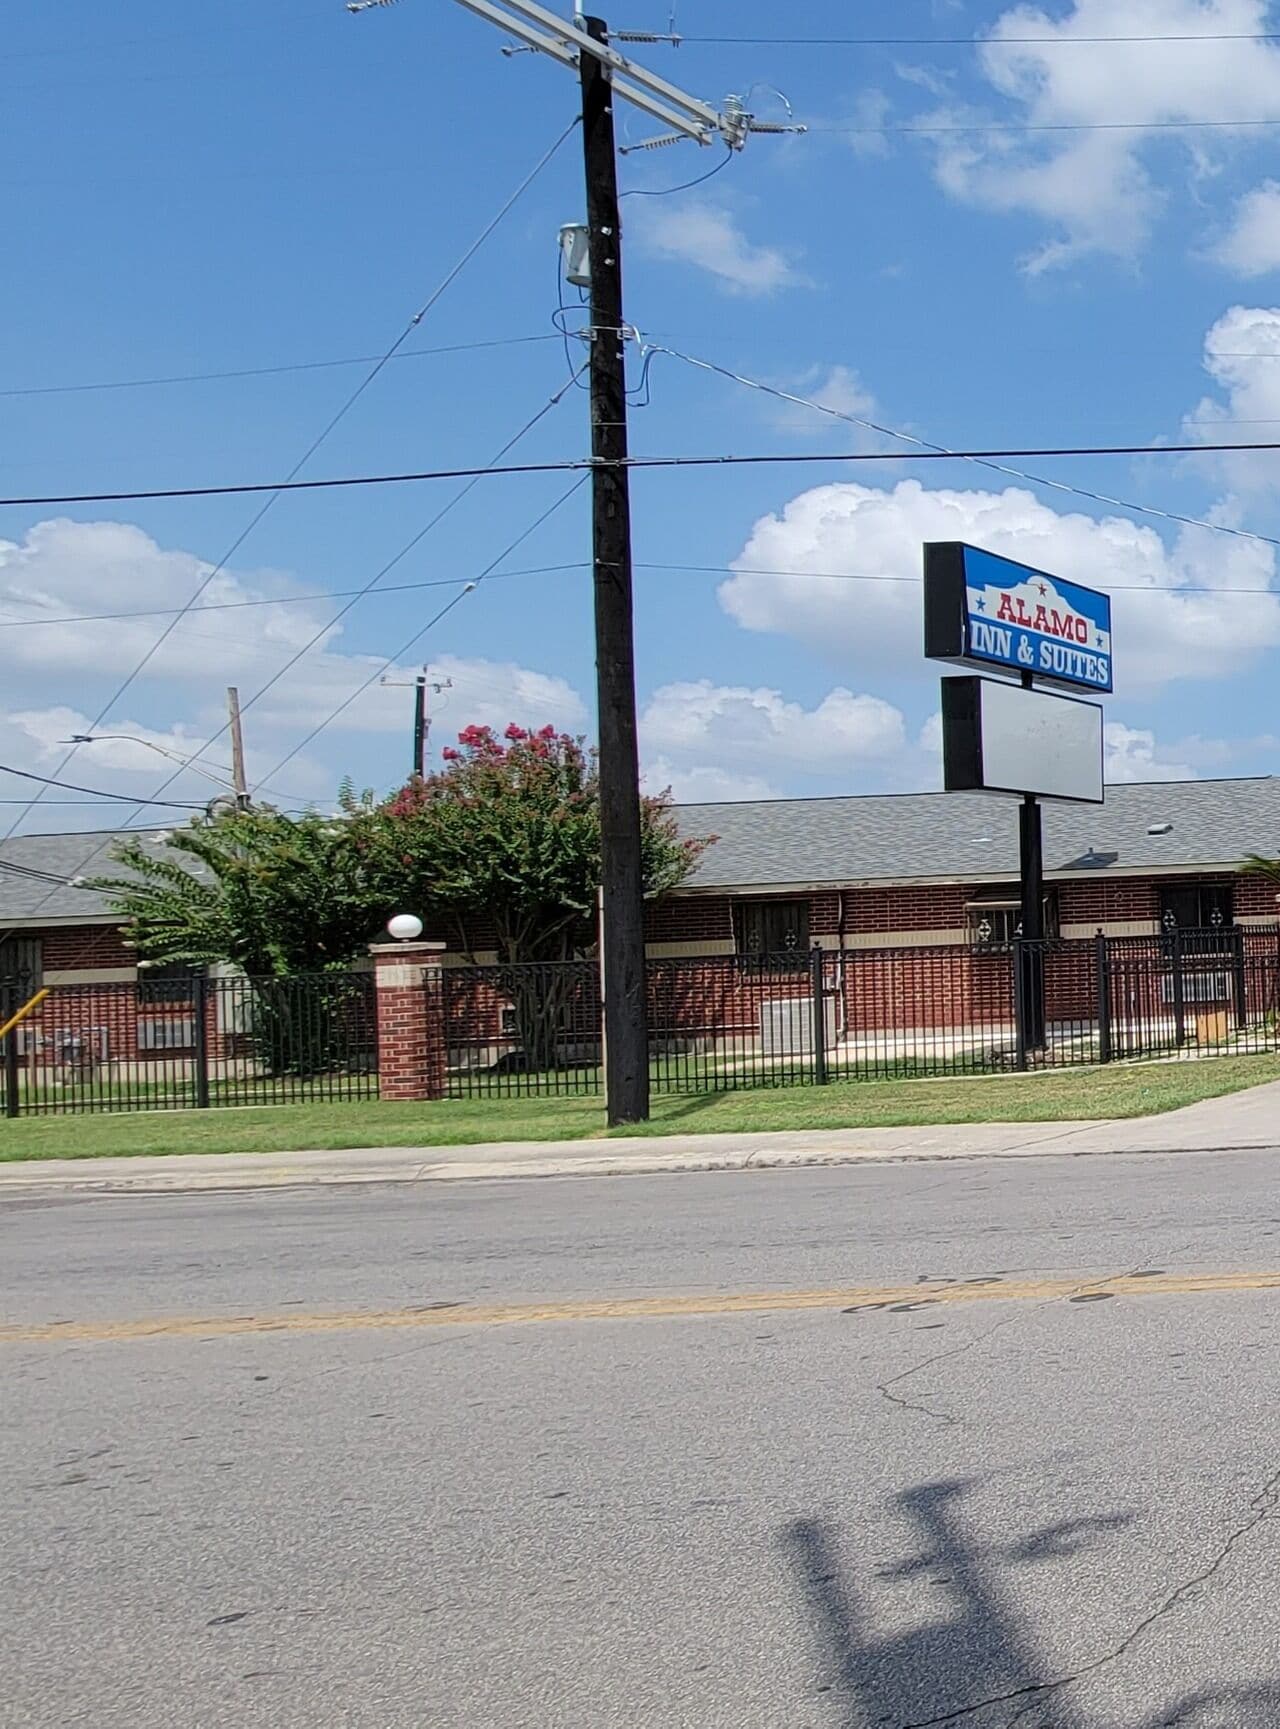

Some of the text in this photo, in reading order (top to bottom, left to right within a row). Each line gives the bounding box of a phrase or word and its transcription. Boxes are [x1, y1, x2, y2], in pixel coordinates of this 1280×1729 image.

[997, 592, 1088, 644] ALAMO
[970, 620, 1109, 684] INN & SUITES
